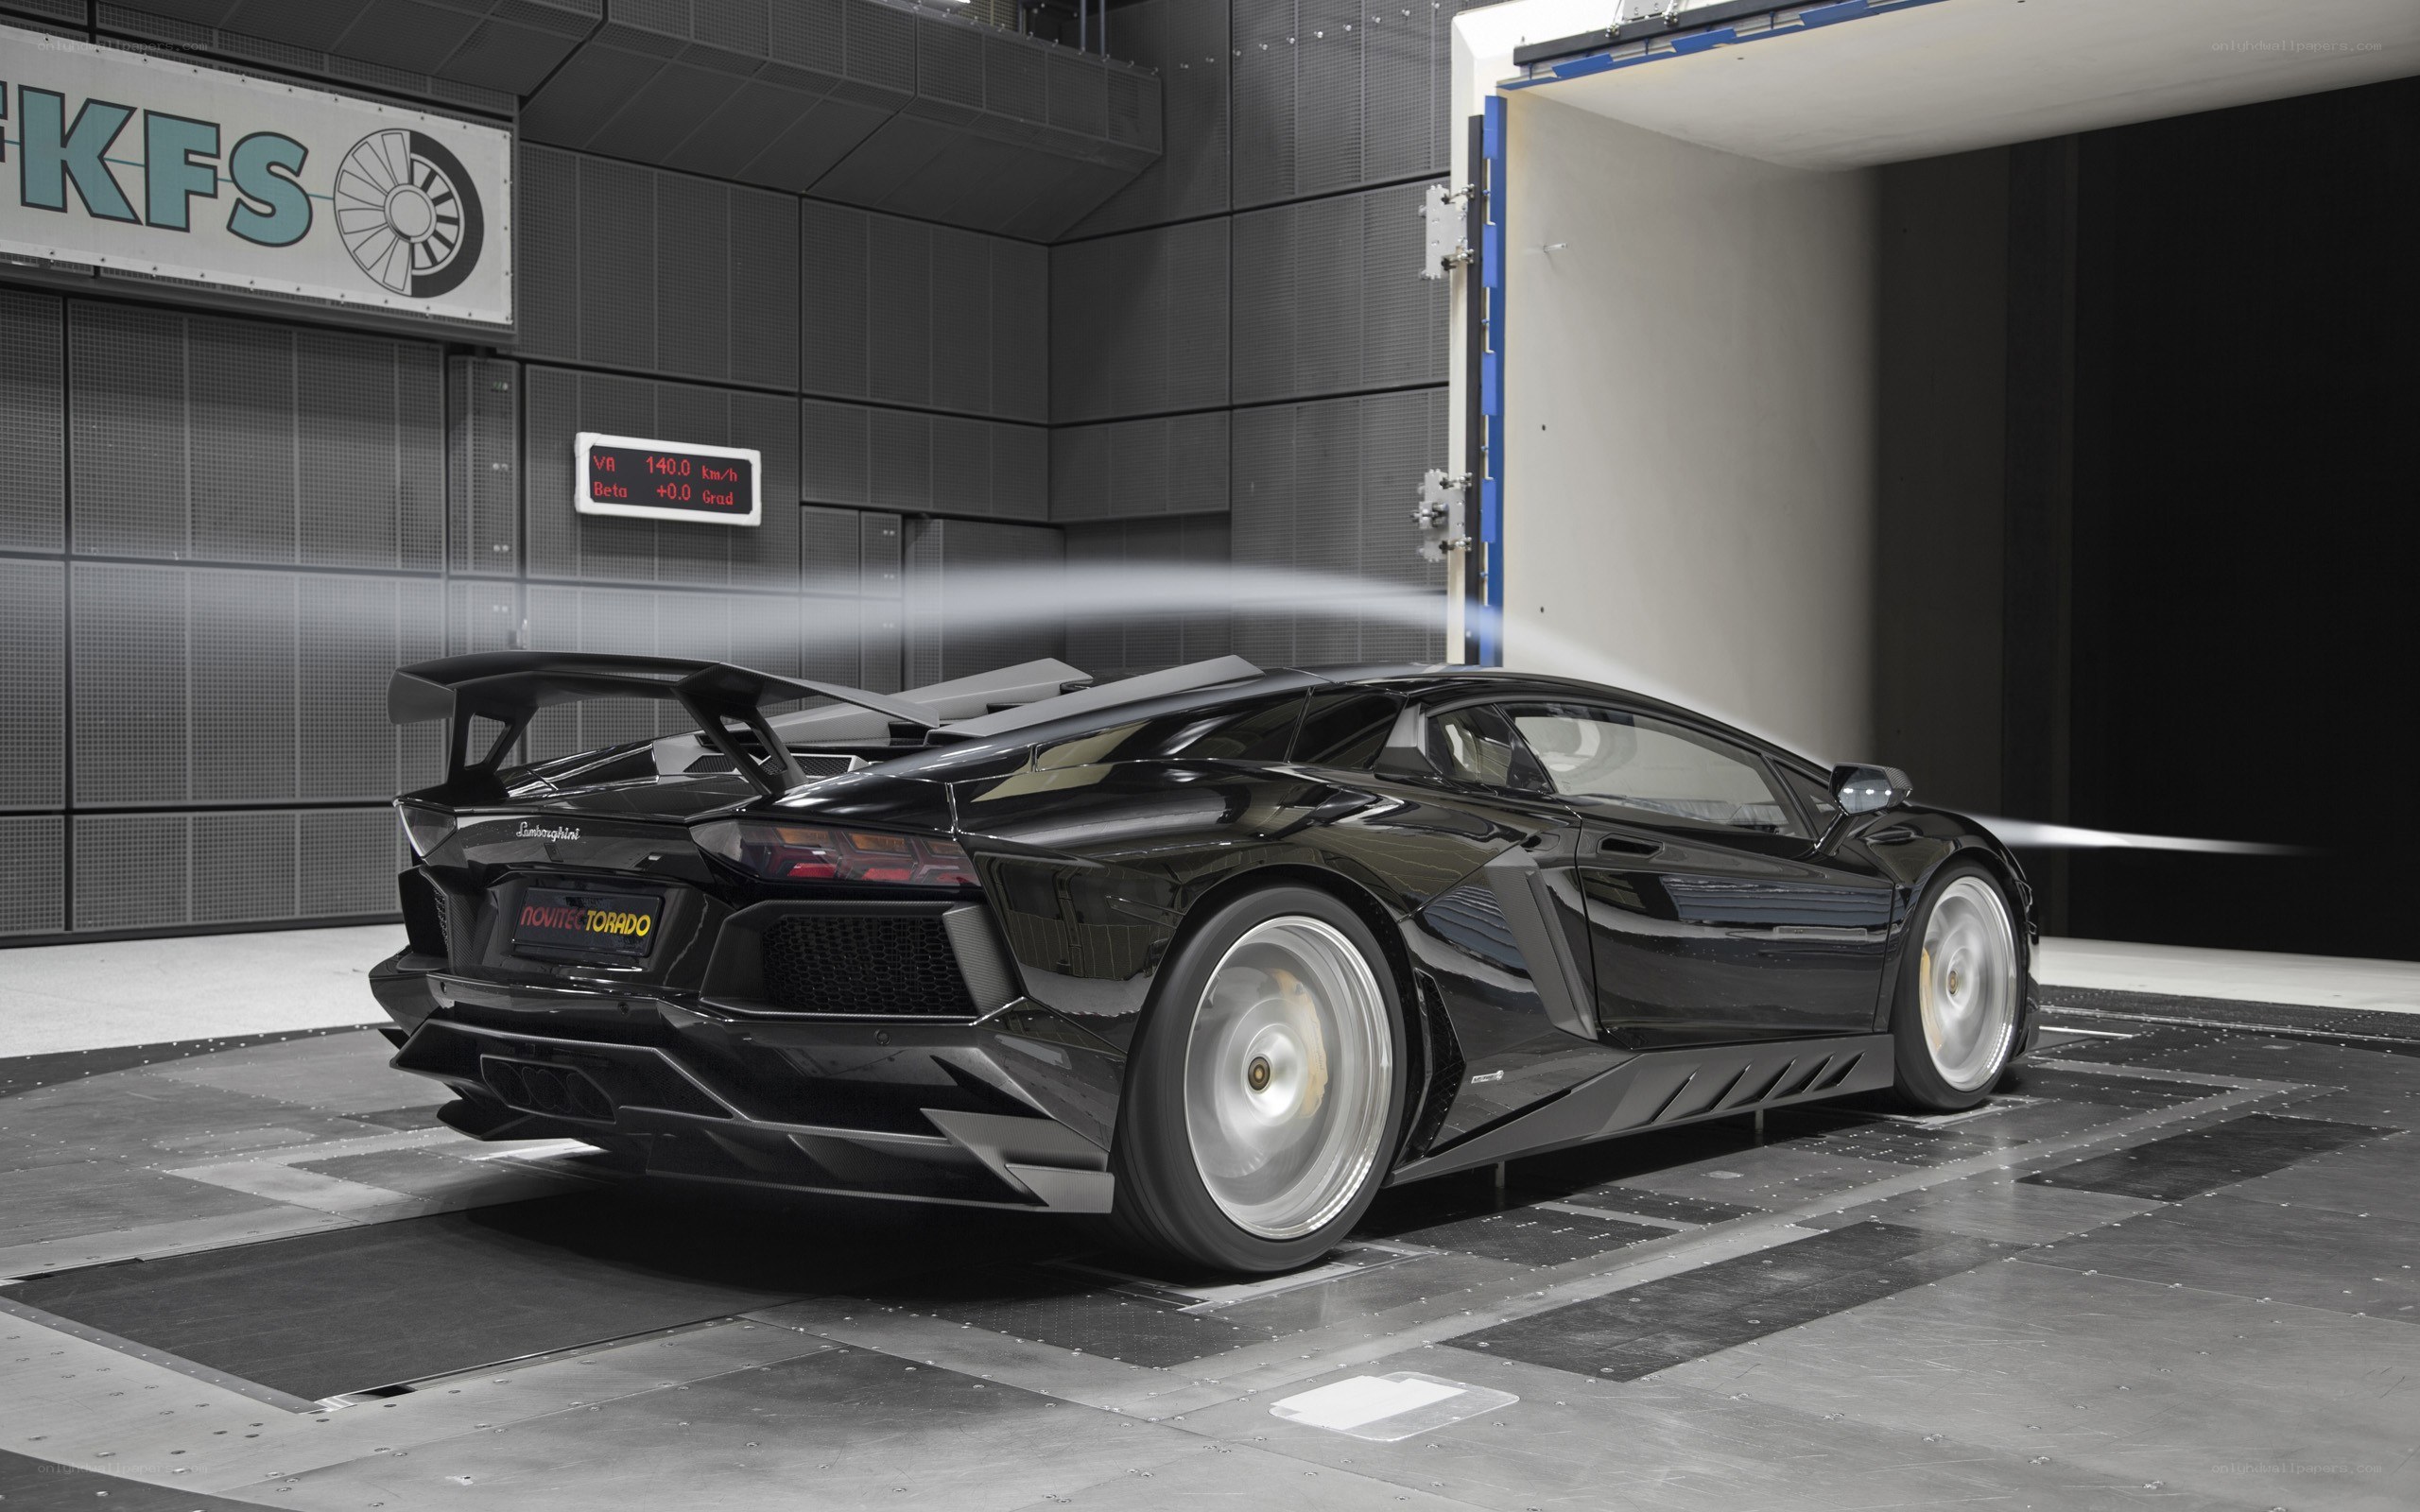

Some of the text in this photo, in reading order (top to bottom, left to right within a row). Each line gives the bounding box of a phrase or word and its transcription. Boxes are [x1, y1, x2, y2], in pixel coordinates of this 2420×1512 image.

[0, 80, 313, 248] KFS
[593, 455, 737, 482] VA 140.0 km/h
[594, 481, 734, 506] Beta +0.0 Grad
[516, 821, 580, 842] Lamborghini
